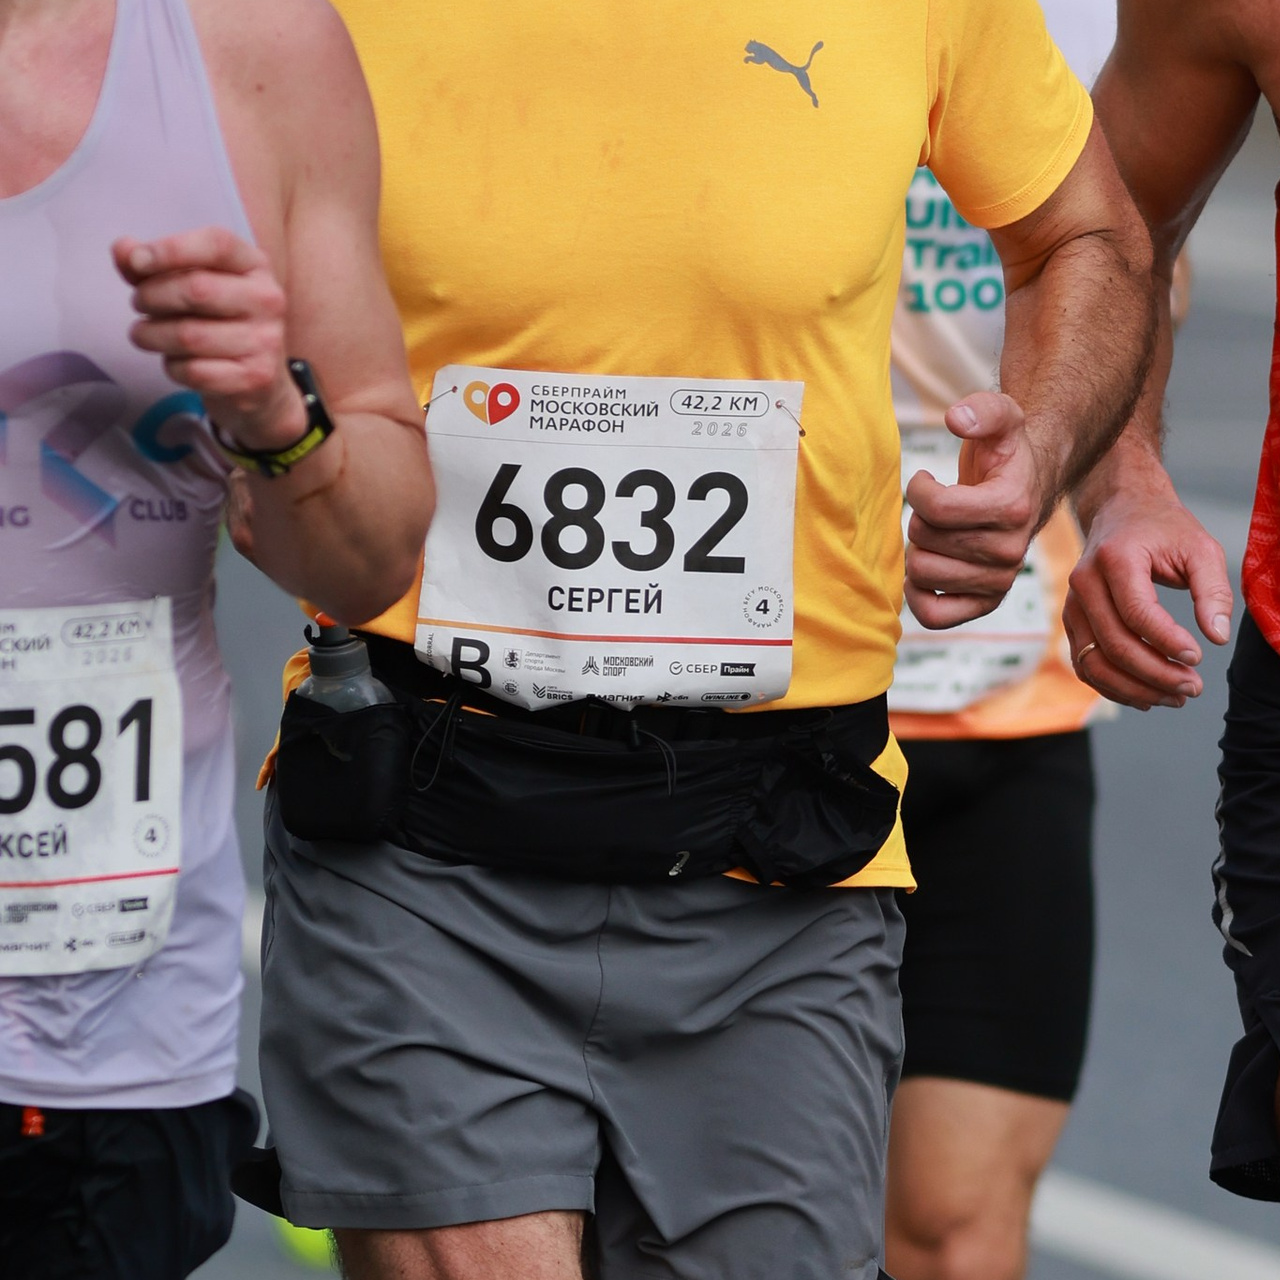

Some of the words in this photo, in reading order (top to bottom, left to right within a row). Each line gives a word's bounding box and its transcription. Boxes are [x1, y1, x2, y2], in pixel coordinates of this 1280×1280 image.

[905, 277, 1004, 313] 100
[531, 385, 627, 400] СБЕРПРАЙМ
[530, 399, 659, 418] МОСКОВСКИЙ
[681, 395, 723, 413] 42,2
[729, 396, 759, 412] КМ
[529, 416, 625, 434] МАРАФОН
[691, 421, 748, 437] 2026
[128, 498, 188, 522] CLUB
[474, 463, 749, 574] 6832
[547, 583, 663, 614] СЕРГЕЙ
[755, 599, 770, 615] 4
[73, 621, 109, 640] 42,2
[451, 637, 492, 689] B
[603, 655, 654, 668] МОСКОВСКИЙ
[686, 664, 718, 674] СБЕР
[723, 665, 750, 674] Прайм
[602, 667, 627, 677] СПОРТ
[547, 692, 574, 700] BRICS
[144, 828, 157, 843] 4
